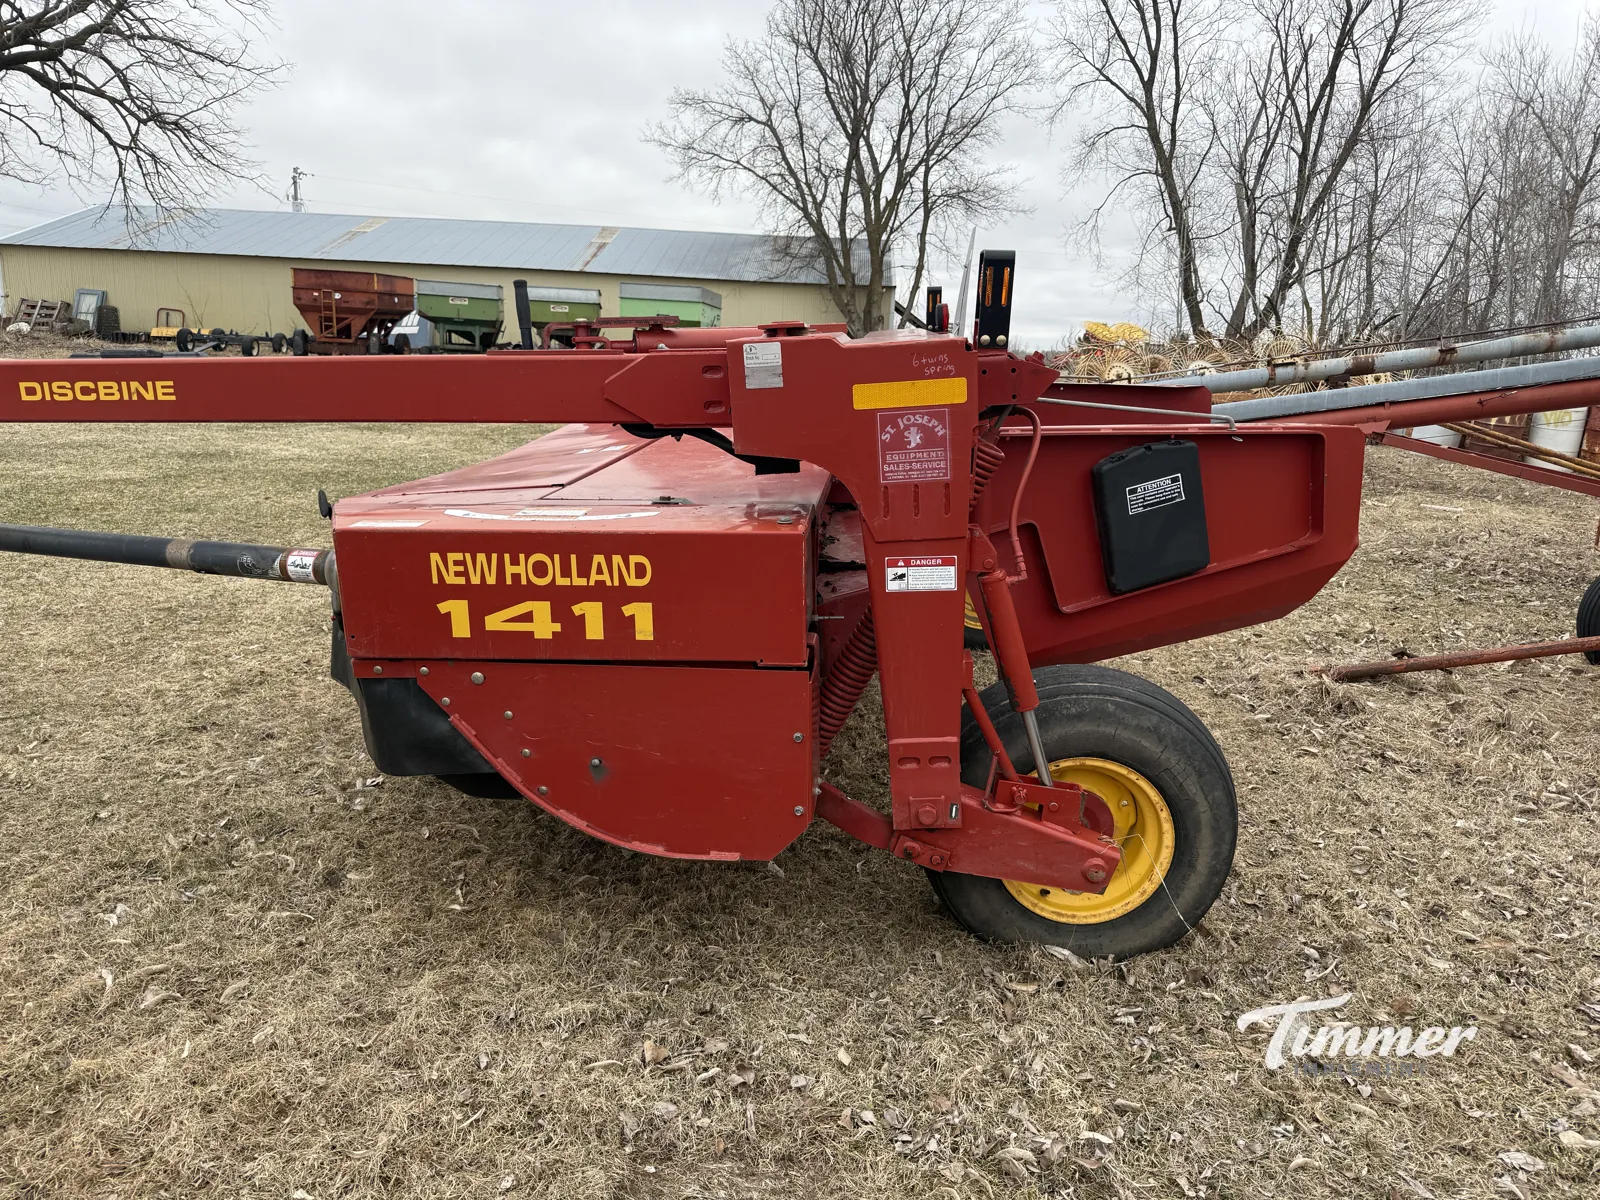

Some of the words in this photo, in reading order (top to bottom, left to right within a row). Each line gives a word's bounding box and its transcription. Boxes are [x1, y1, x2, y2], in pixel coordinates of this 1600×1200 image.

[912, 353, 919, 367] 6
[921, 353, 949, 364] turns
[924, 364, 956, 376] spring
[18, 380, 177, 401] DISCBINE
[897, 414, 946, 437] JOSEPH
[883, 460, 946, 472] SALES-SERVICE
[1137, 478, 1172, 494] ATTENTION
[429, 552, 498, 585] NEW
[504, 552, 653, 587] HOLLAND
[910, 558, 942, 566] DANGER
[436, 599, 655, 641] 1411
